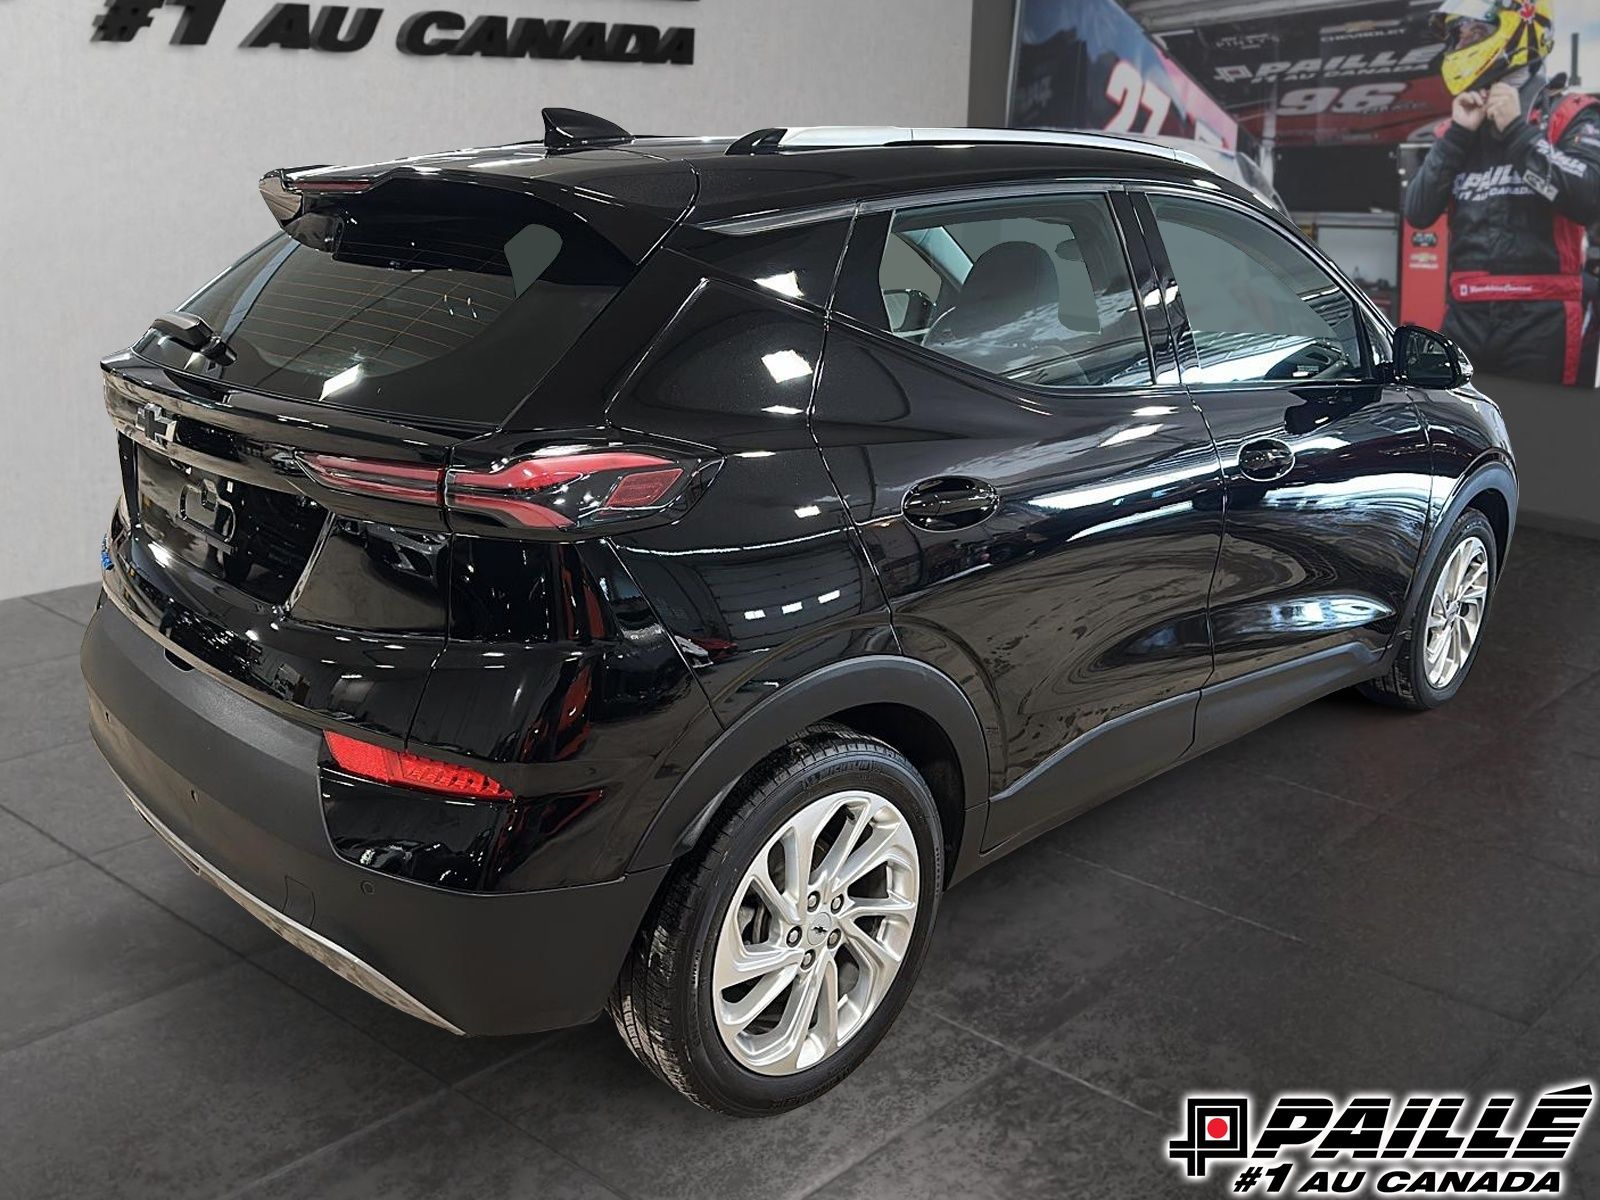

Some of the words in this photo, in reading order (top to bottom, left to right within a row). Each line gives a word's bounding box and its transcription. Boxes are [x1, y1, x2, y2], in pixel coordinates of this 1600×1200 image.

[90, 0, 226, 45] #1
[237, 3, 384, 52] AU
[396, 10, 696, 65] CANADA
[1280, 73, 1316, 82] AU
[1323, 63, 1429, 79] CANADA
[1276, 82, 1407, 116] 96
